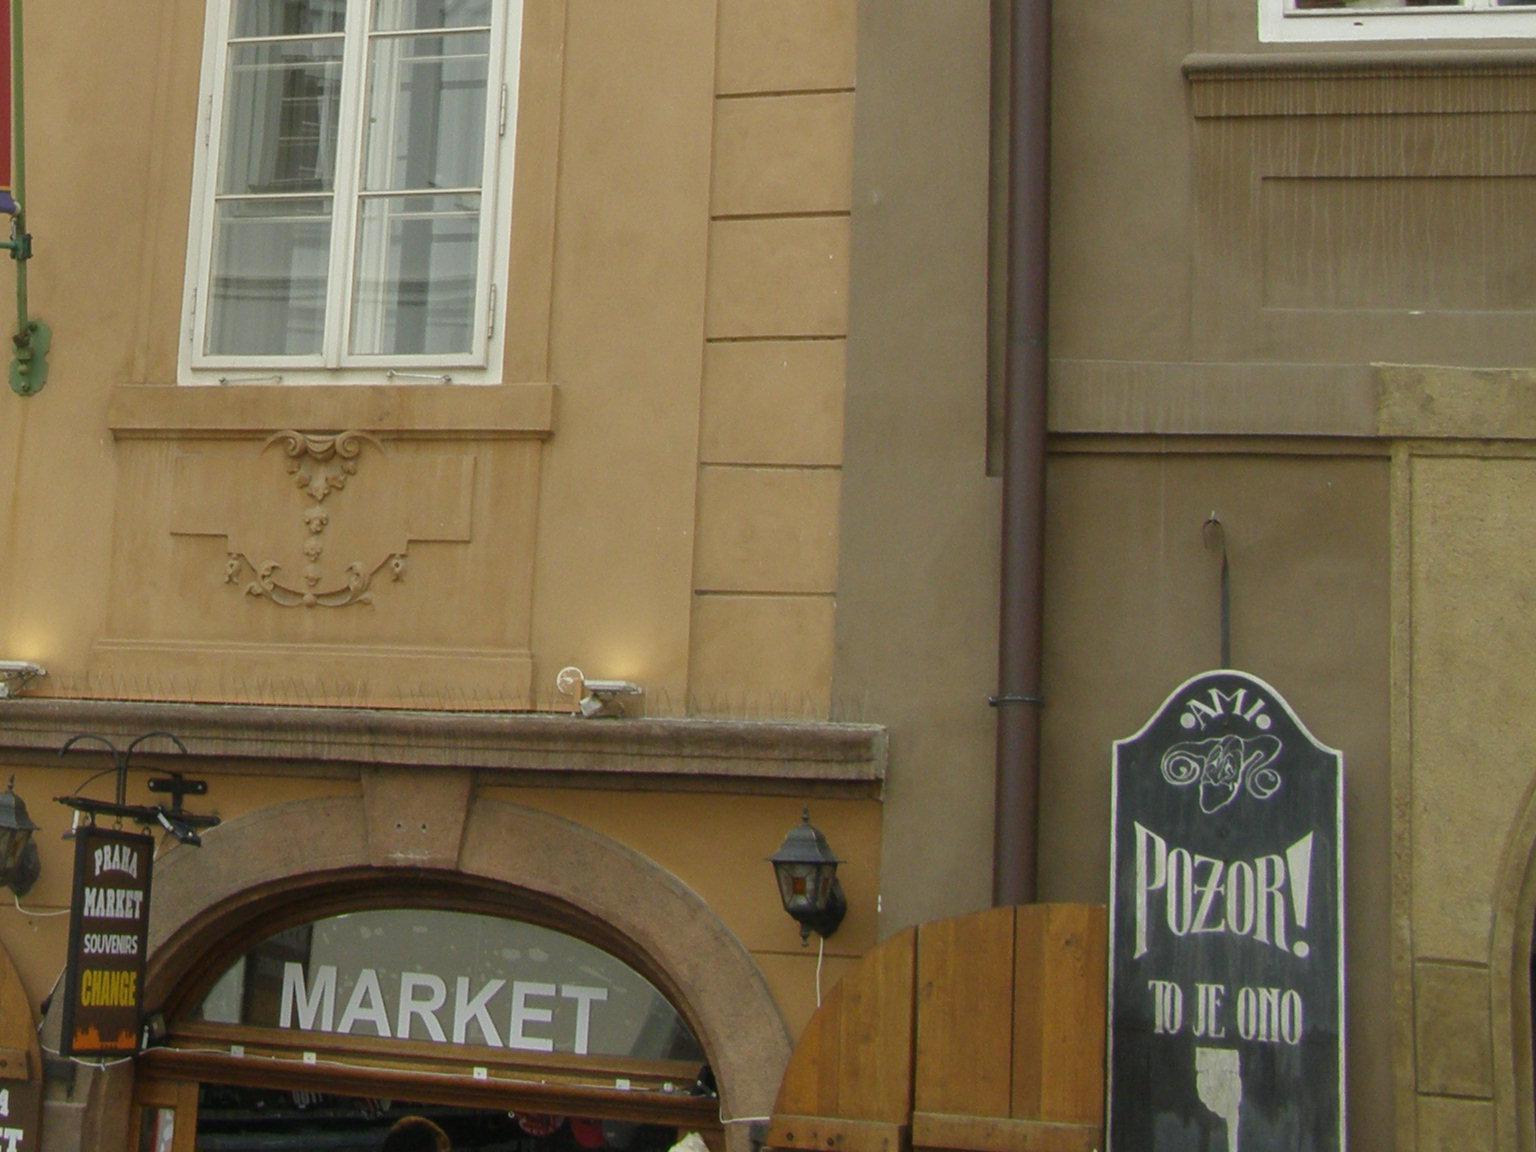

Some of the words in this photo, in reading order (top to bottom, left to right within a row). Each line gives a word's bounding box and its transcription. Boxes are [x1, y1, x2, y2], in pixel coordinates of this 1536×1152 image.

[94, 844, 138, 879] PRAHA
[83, 887, 143, 919] MARKET
[1133, 820, 1315, 959] POZOR!
[84, 933, 138, 955] SOUVENIRS
[80, 968, 138, 1007] CHANGE
[279, 961, 609, 1056] MARKET
[1148, 980, 1183, 1034] TO
[1193, 983, 1226, 1039] JE
[1237, 987, 1304, 1045] ONO
